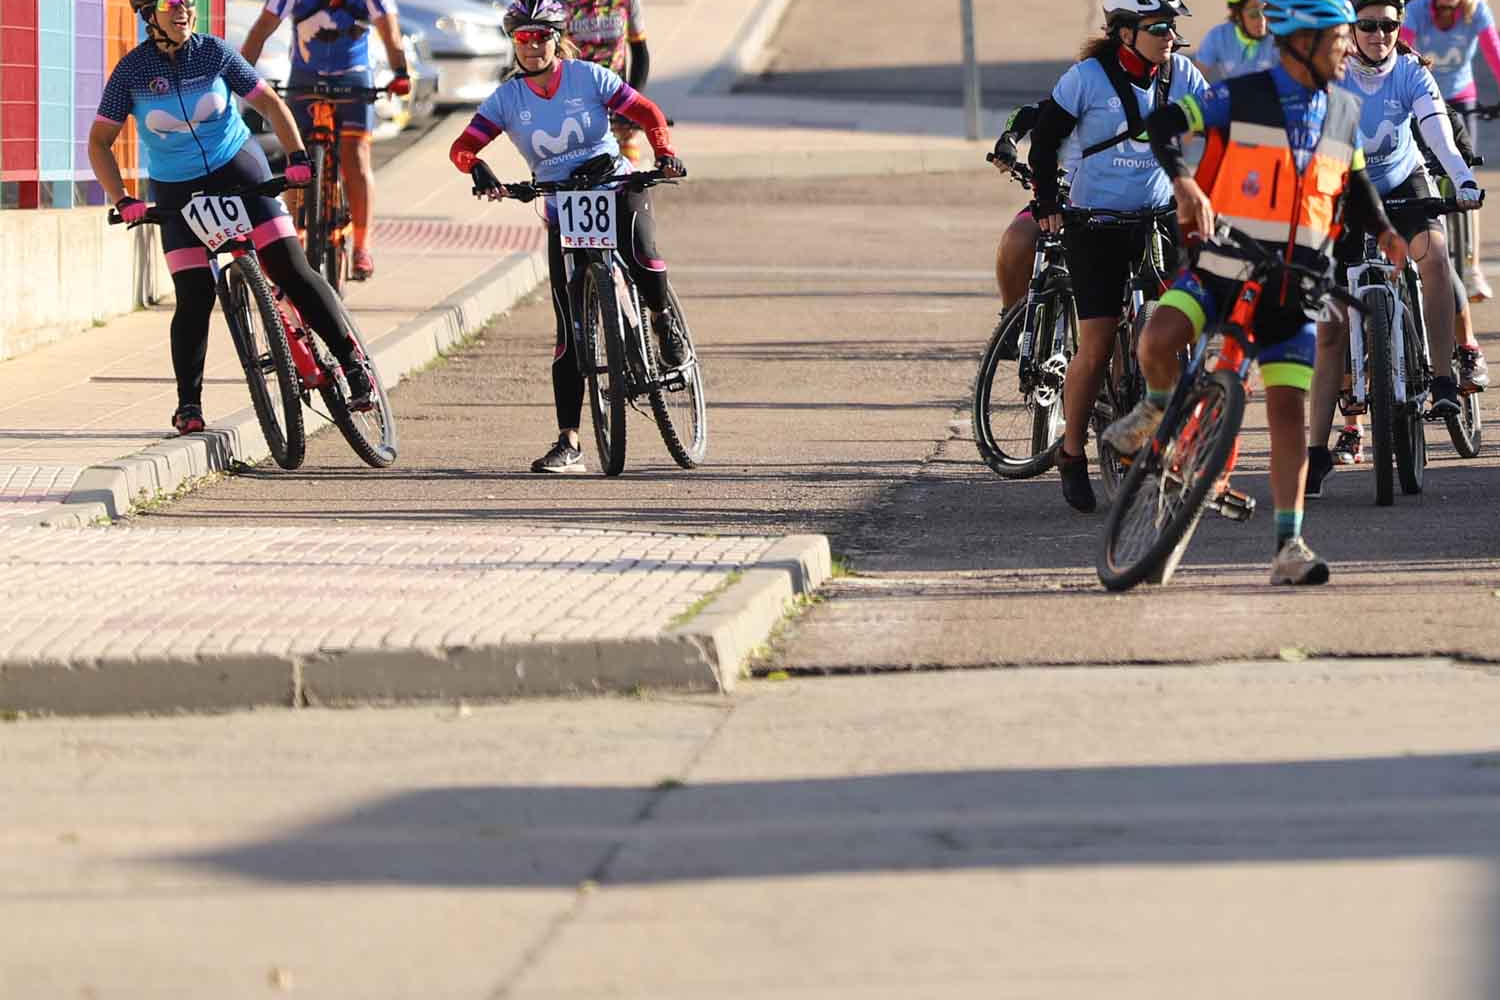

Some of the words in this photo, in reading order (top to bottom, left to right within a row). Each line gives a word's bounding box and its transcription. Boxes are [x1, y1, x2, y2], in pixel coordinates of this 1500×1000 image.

[189, 196, 239, 235] 116
[562, 195, 610, 233] 138
[208, 223, 251, 249] R.F.E.C.
[564, 236, 615, 247] R.F.E.C.
